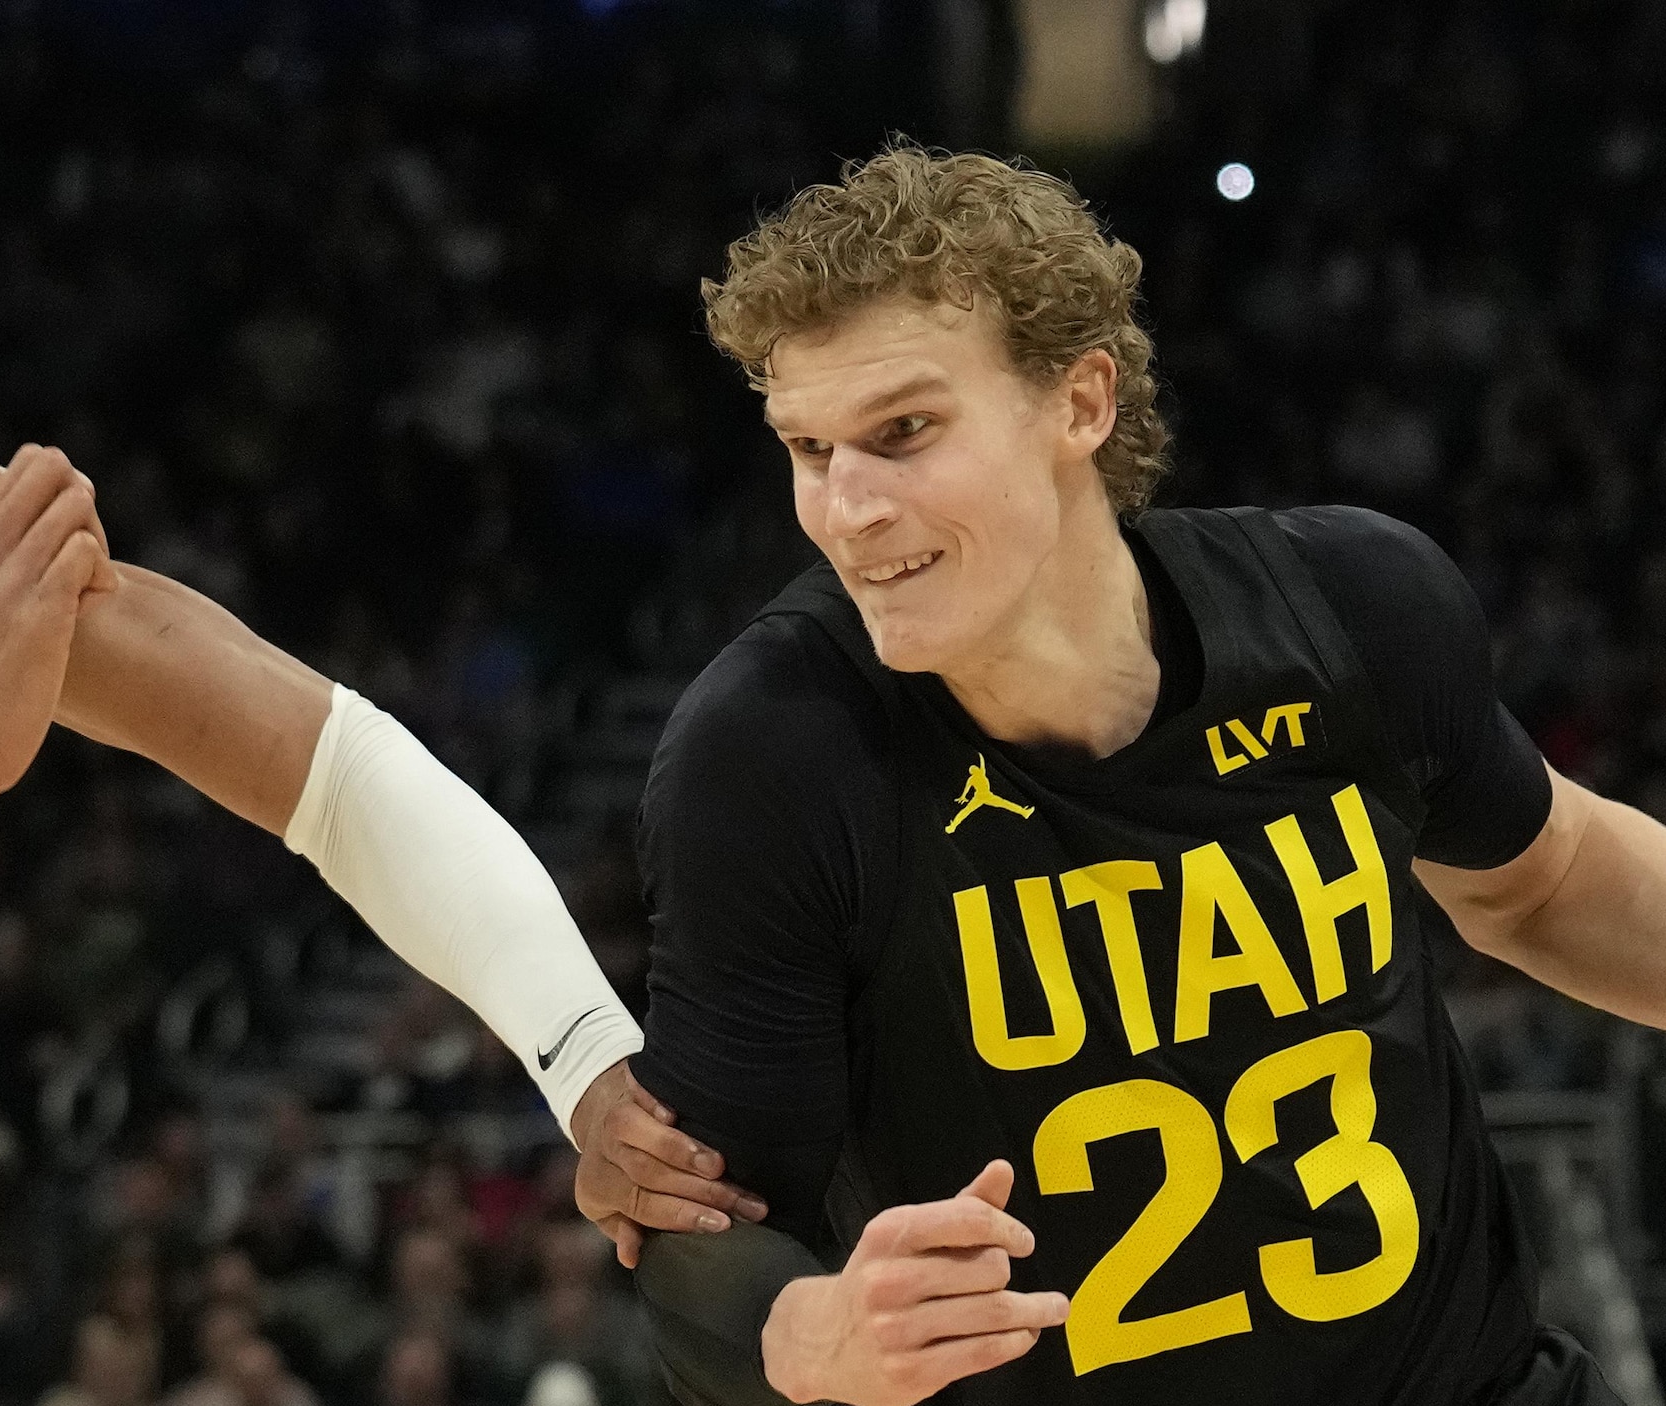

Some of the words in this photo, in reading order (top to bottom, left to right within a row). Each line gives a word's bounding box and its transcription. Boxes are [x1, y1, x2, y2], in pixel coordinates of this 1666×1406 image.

[1205, 702, 1312, 776] LVT
[952, 784, 1393, 1071] UTAH
[1032, 1029, 1420, 1377] 23
